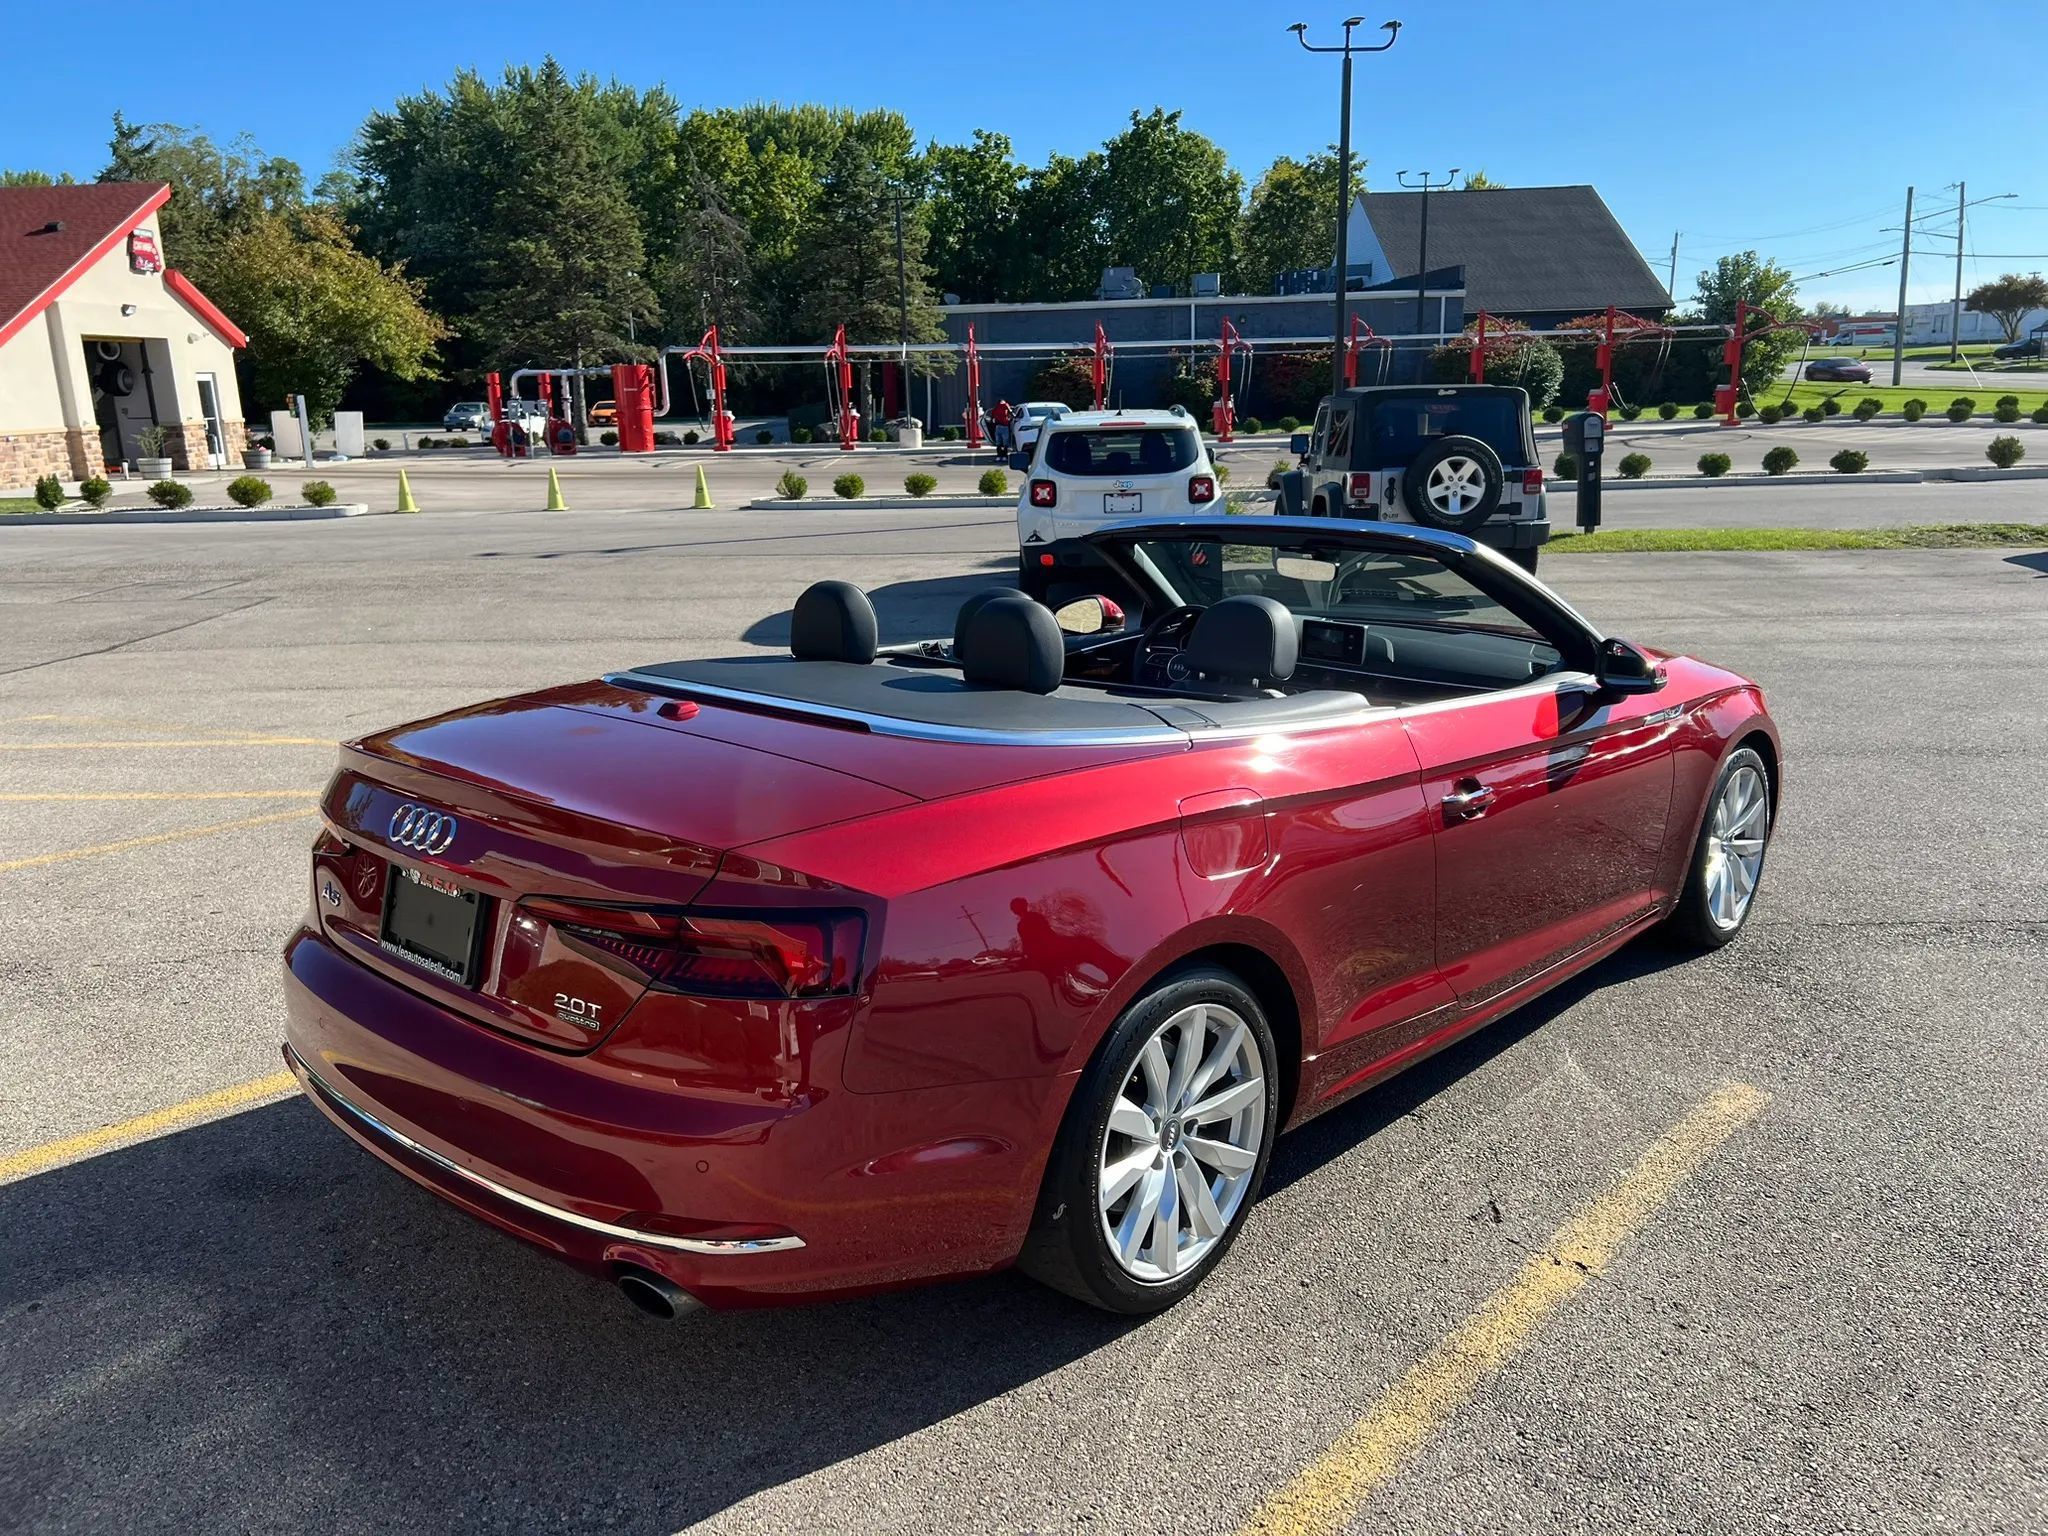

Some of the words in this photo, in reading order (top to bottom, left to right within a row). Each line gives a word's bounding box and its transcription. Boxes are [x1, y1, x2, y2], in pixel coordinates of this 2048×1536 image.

[1113, 480, 1133, 489] Jeep
[321, 879, 341, 906] A5
[381, 940, 461, 983] www.leoautosalesllc.com
[554, 993, 602, 1018] 2.0T
[558, 1011, 598, 1029] quattro
